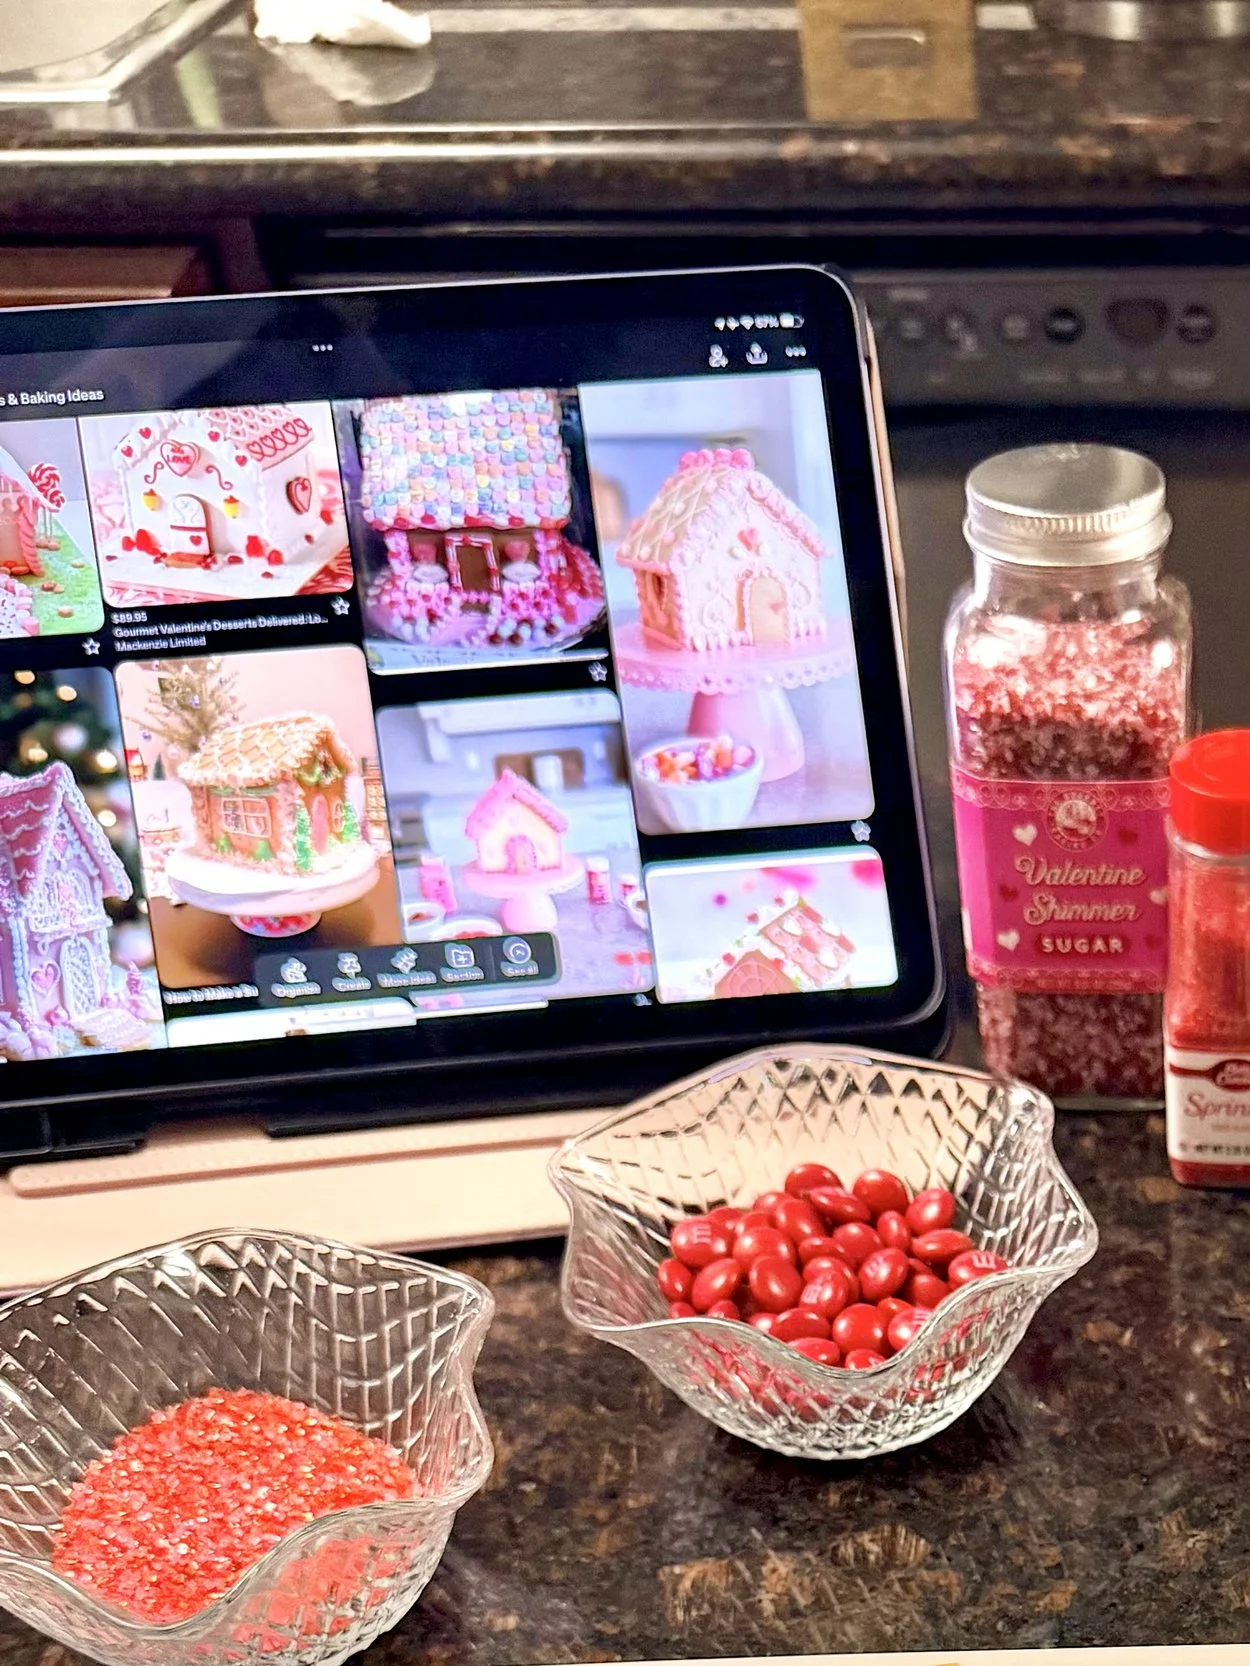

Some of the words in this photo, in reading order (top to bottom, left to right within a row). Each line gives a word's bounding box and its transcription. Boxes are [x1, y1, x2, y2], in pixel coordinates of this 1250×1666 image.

[8, 393, 19, 405] &
[20, 391, 66, 405] Baking
[67, 388, 105, 402] Ideas
[112, 610, 148, 624] $89.95
[114, 626, 160, 638] Gourmet
[160, 622, 212, 635] Valentine's
[213, 619, 258, 631] Desserts
[115, 639, 169, 652] Mackenzie
[170, 637, 206, 648] Limited
[1014, 853, 1147, 886] Valentine
[1023, 891, 1142, 926] Shimmer
[1041, 937, 1124, 953] SUGAR
